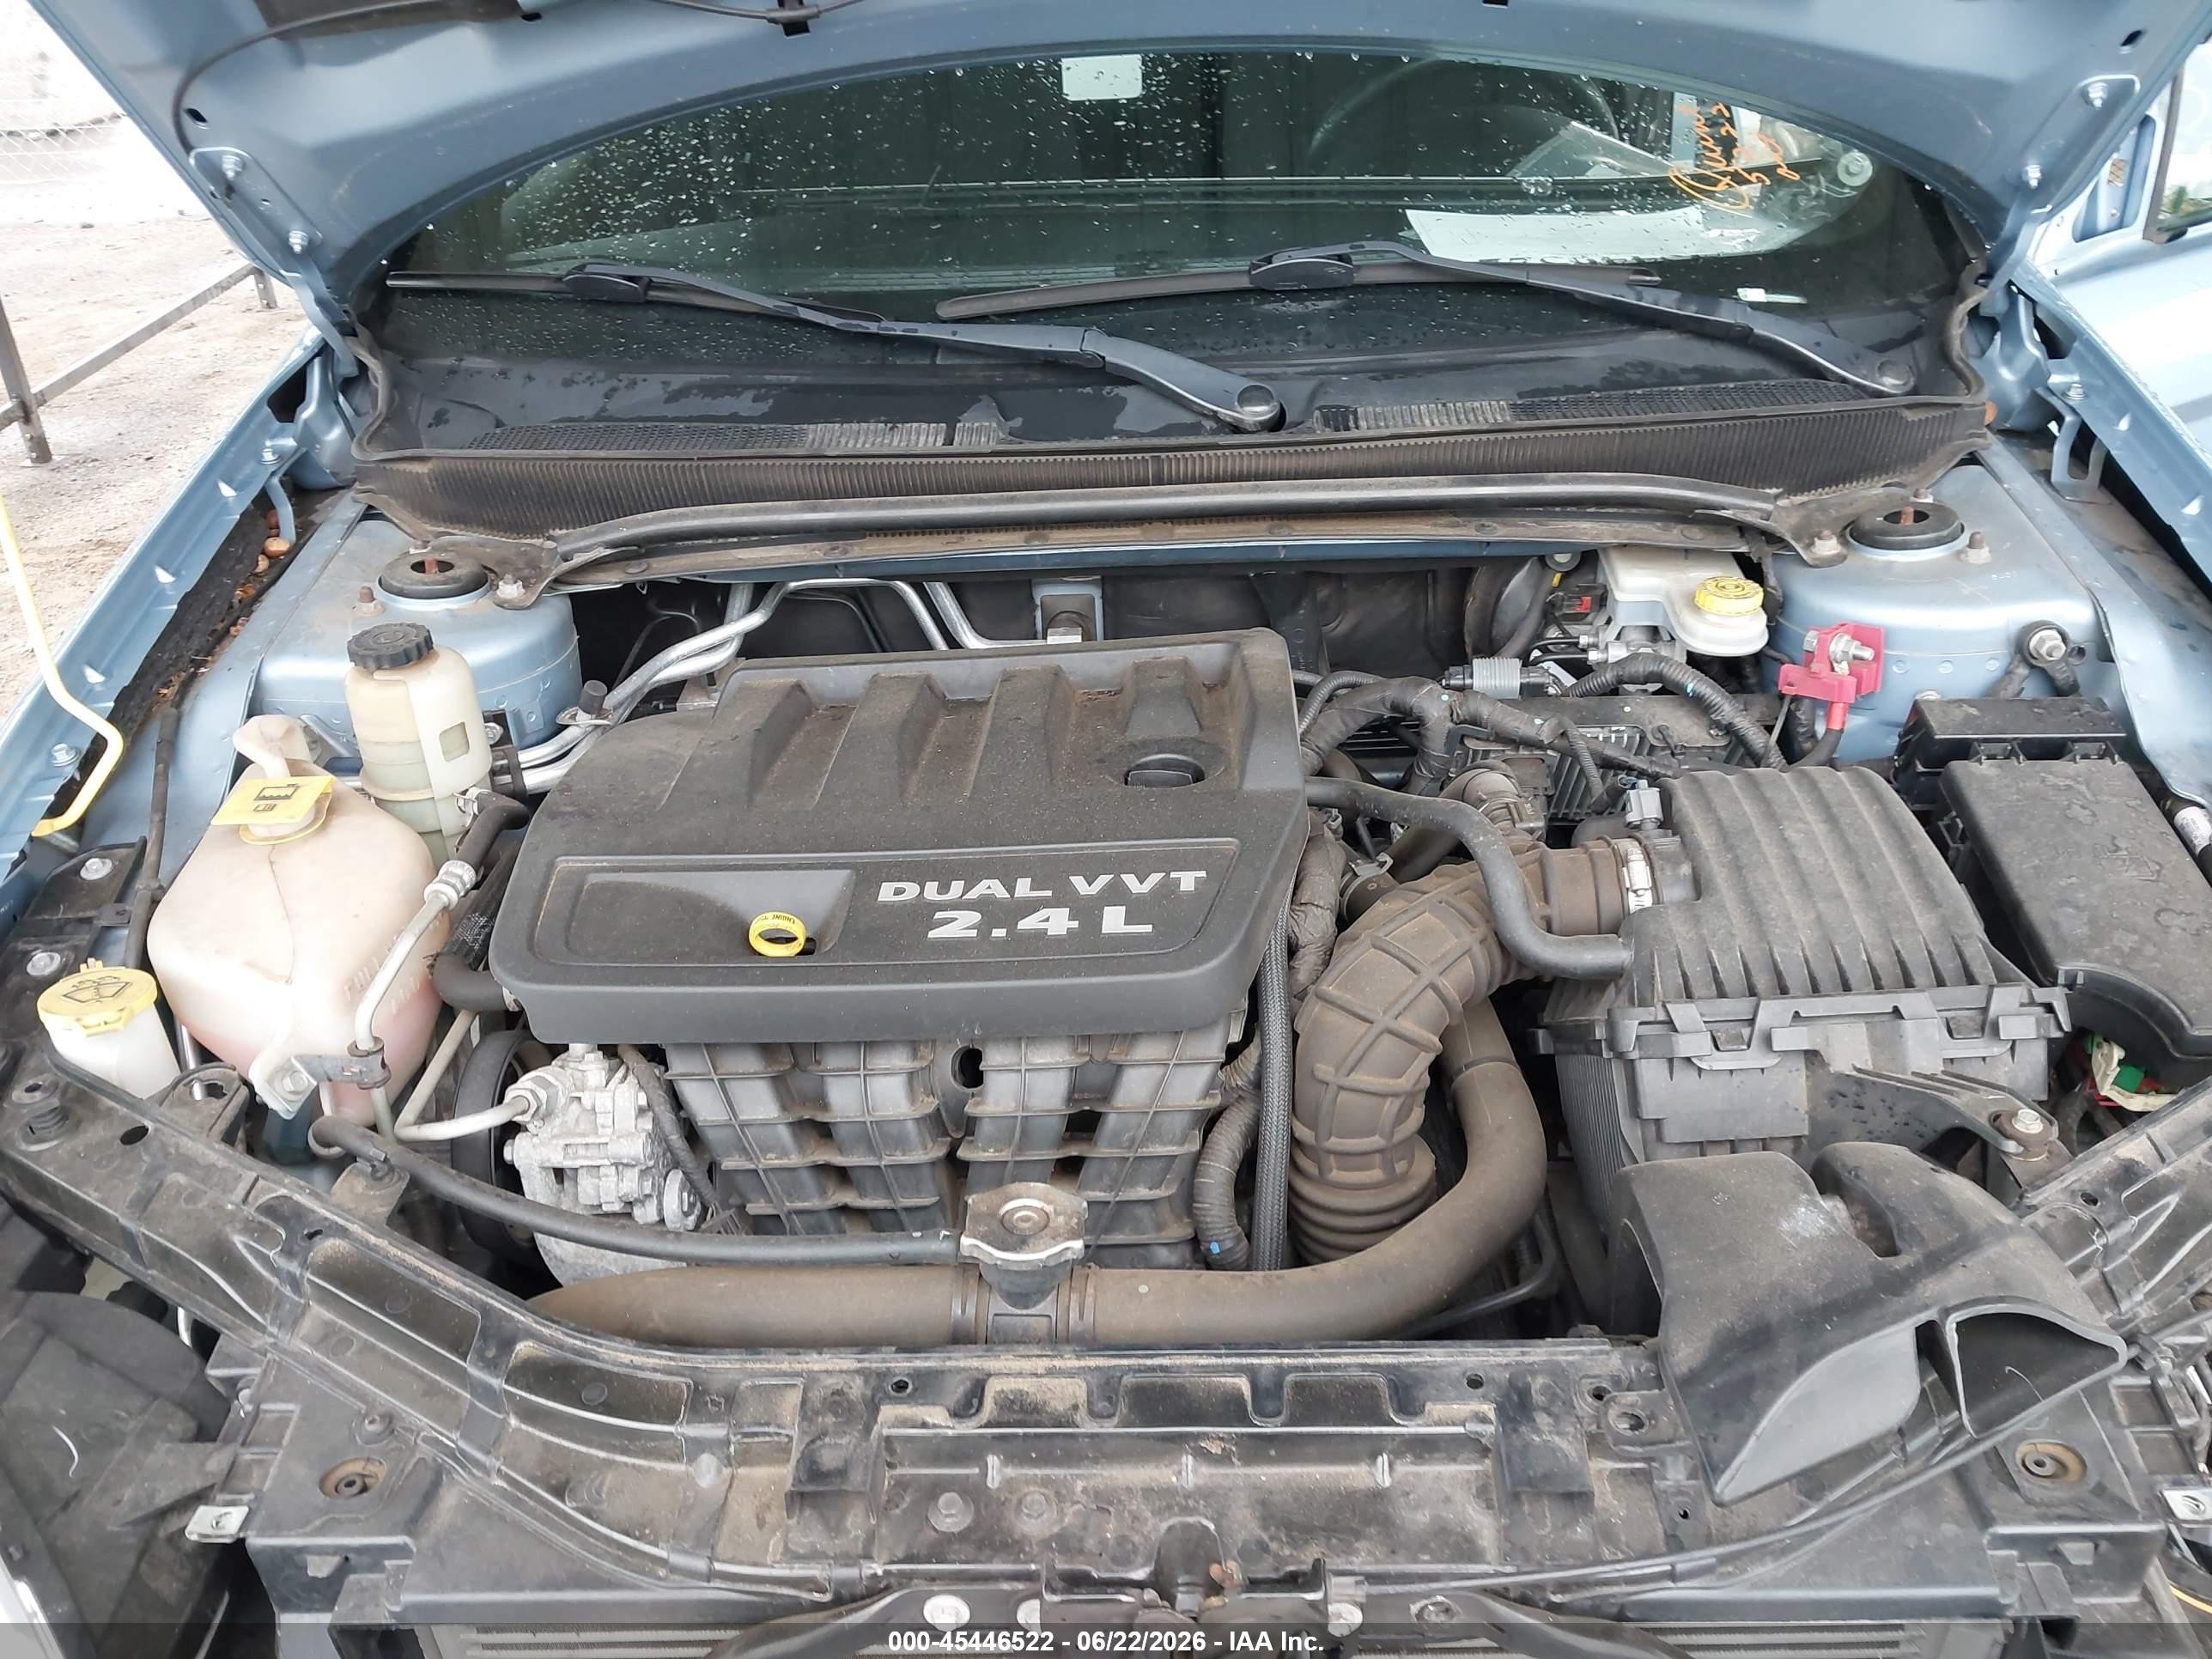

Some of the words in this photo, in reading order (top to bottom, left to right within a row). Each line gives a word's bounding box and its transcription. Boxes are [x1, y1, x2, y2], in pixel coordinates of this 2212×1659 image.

[877, 878, 1053, 902] DUAL
[1068, 870, 1207, 896] VVT
[927, 907, 1079, 939] 2.4
[1101, 905, 1153, 934] L
